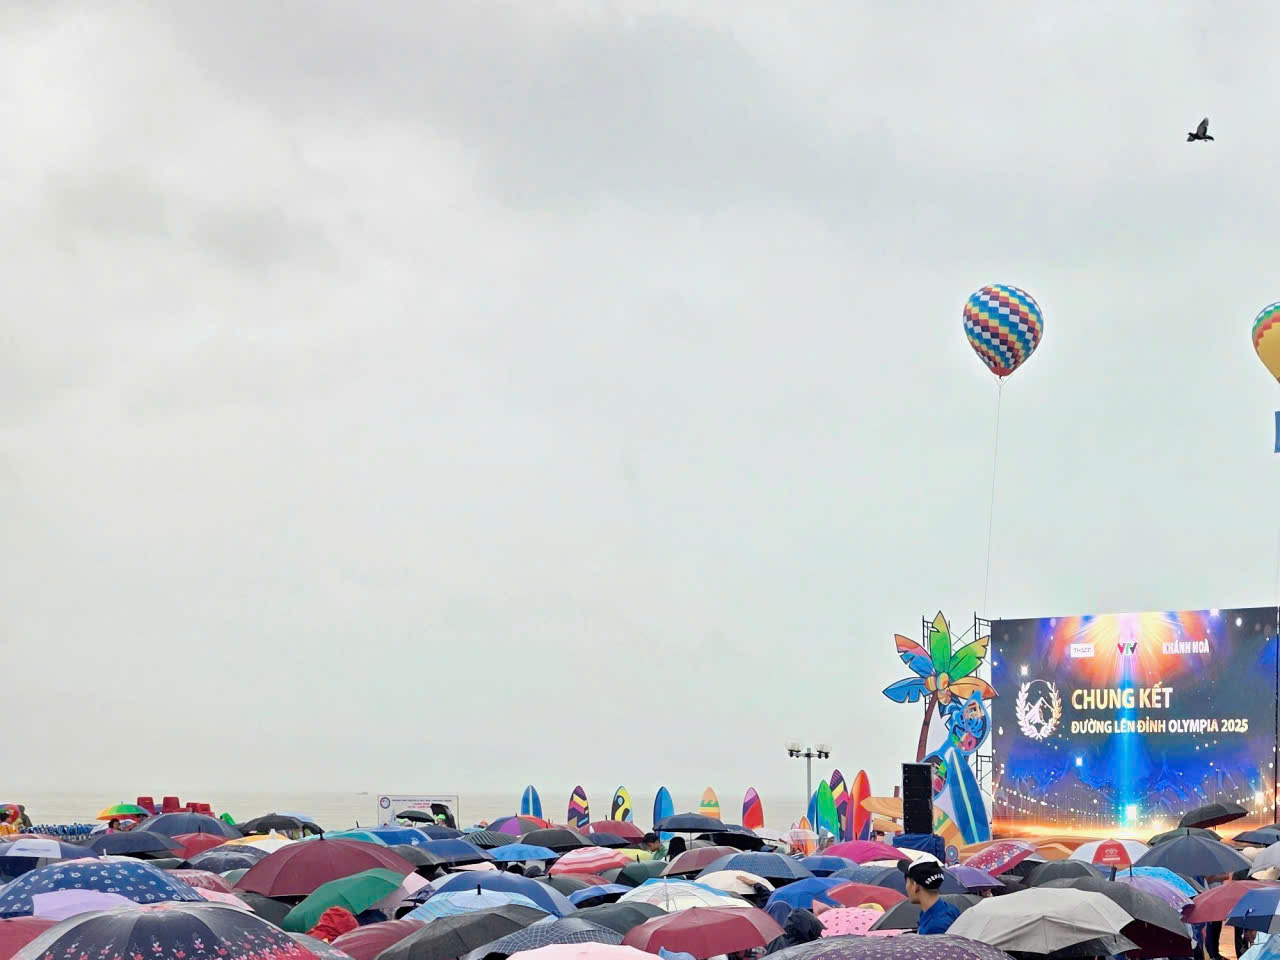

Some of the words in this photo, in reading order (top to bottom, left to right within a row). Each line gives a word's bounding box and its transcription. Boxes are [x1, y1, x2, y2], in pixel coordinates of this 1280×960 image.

[1117, 642, 1138, 655] VTV
[1162, 640, 1190, 655] KHÁNH
[1071, 688, 1135, 710] CHUNG
[1139, 682, 1173, 709] KẾT
[1071, 718, 1113, 734] ĐƯỜNG
[1114, 718, 1136, 734] LÊN
[1137, 716, 1166, 734] ĐỈNH
[1168, 719, 1219, 734] OLYMPIA
[1221, 718, 1249, 733] 2025
